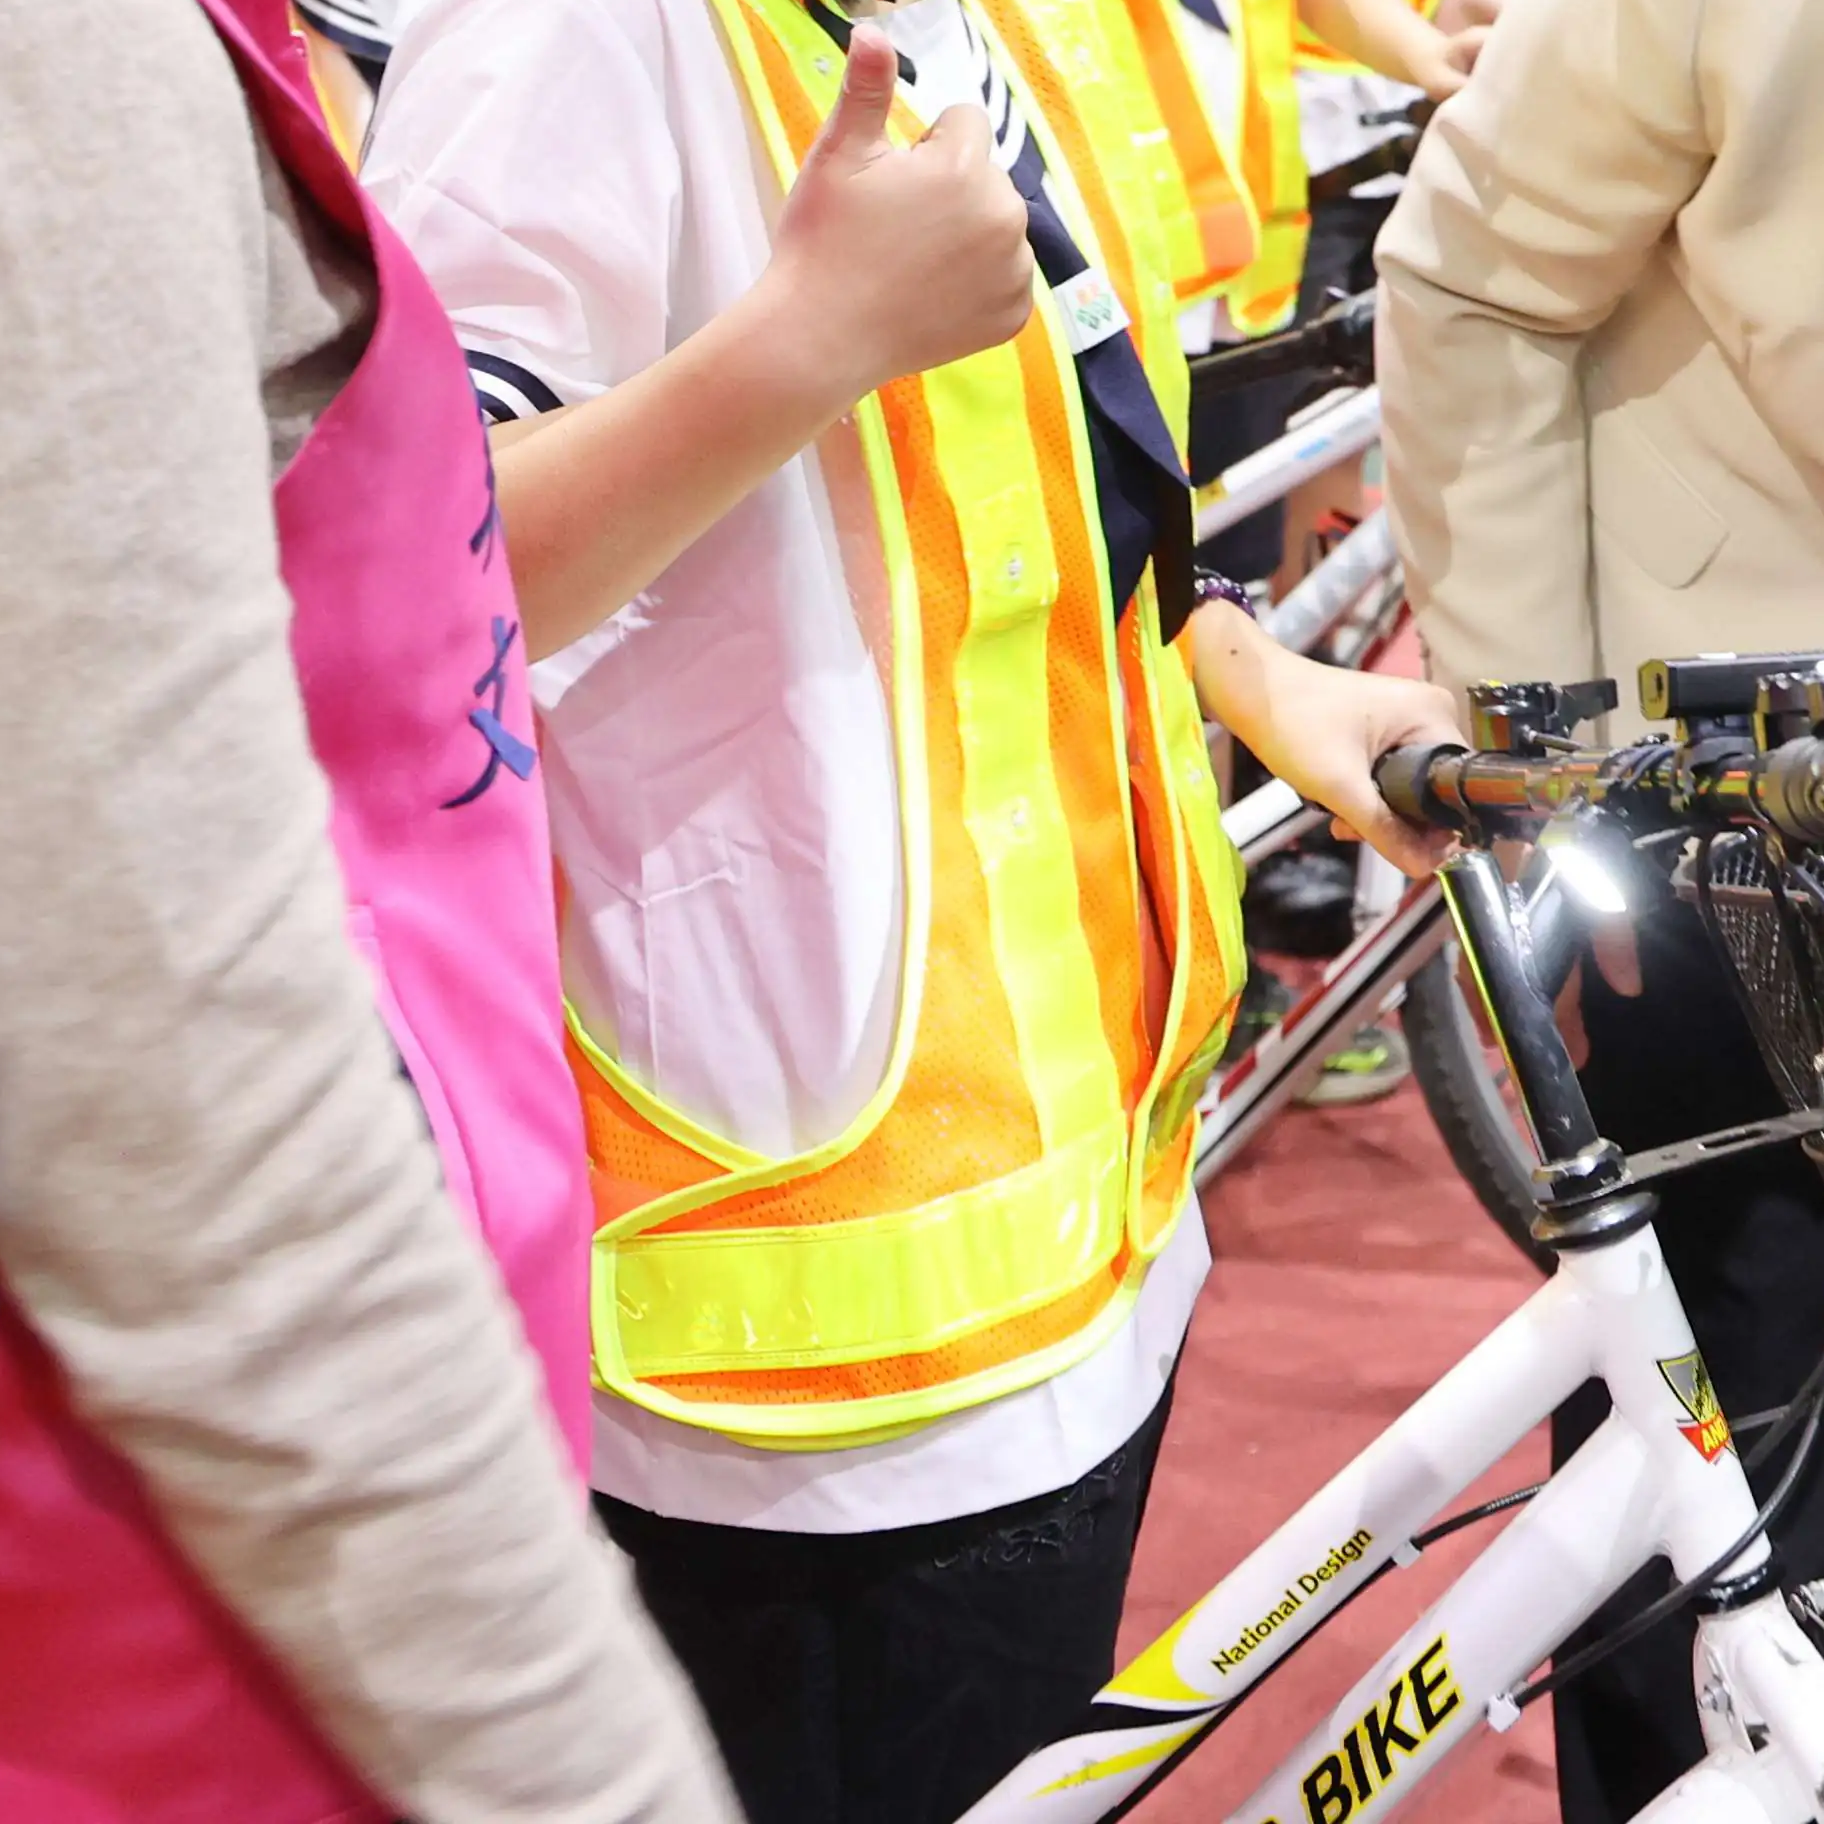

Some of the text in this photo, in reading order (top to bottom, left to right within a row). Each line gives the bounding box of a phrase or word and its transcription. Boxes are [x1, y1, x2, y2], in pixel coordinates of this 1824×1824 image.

[1210, 1527, 1374, 1676] National Design
[1300, 1633, 1461, 1824] BIKE
